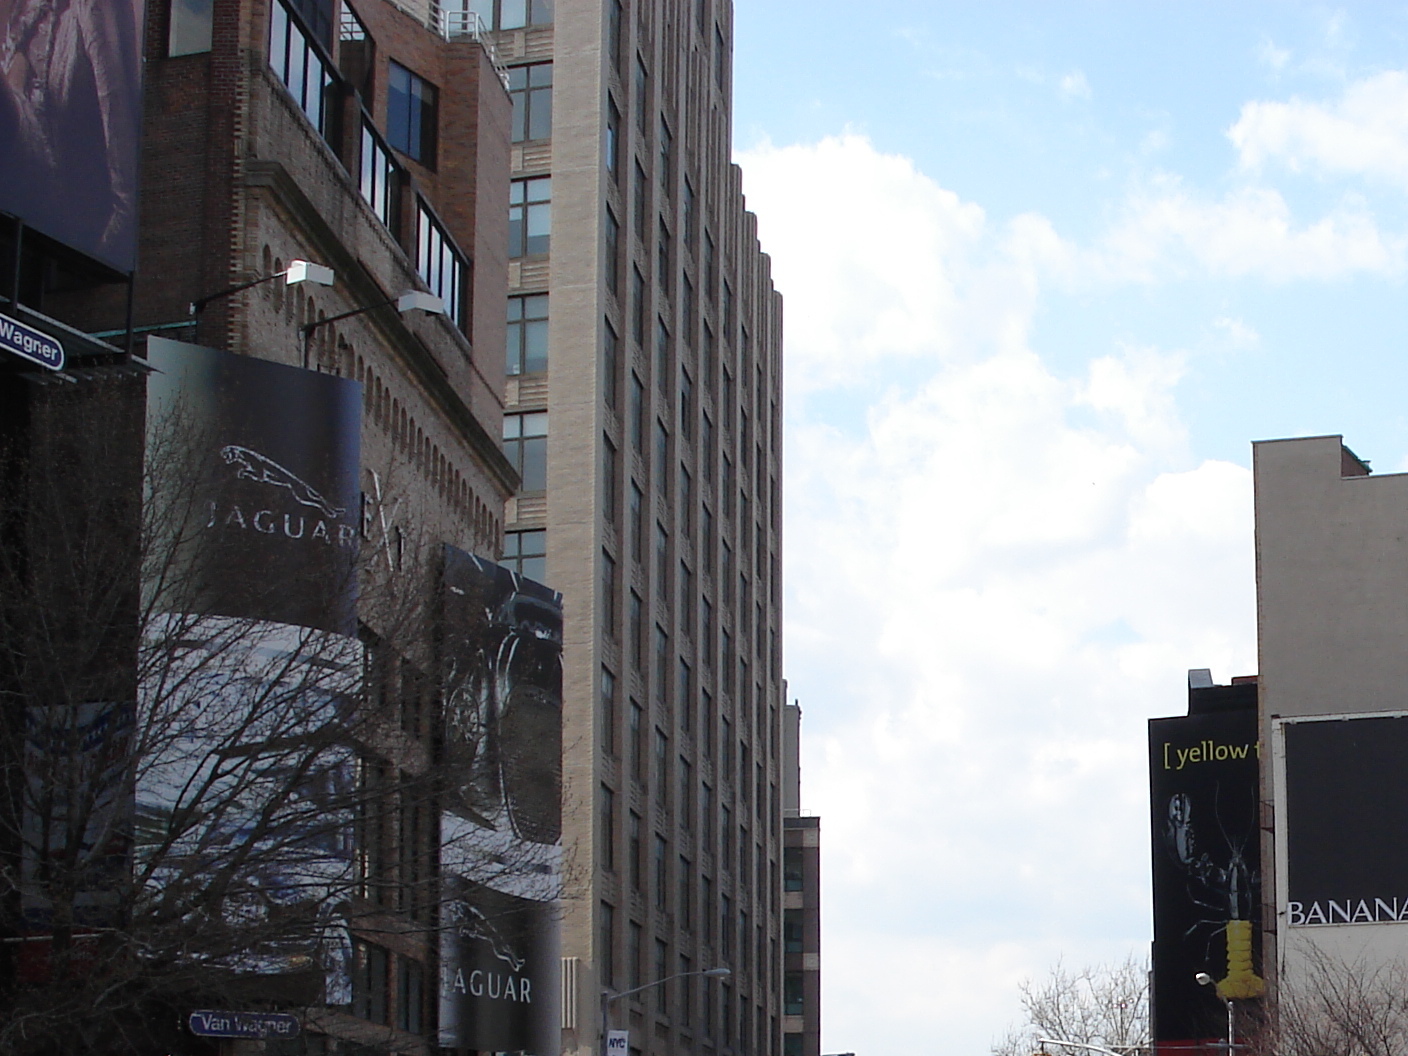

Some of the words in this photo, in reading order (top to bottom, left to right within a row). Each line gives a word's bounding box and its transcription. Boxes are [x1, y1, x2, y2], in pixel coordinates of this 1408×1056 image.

[0, 318, 58, 361] Wagner
[204, 501, 356, 547] JAGUAR
[1176, 740, 1249, 770] yellow
[201, 1013, 230, 1031] Van
[234, 1016, 293, 1039] Wagner
[608, 1037, 627, 1049] NYC
